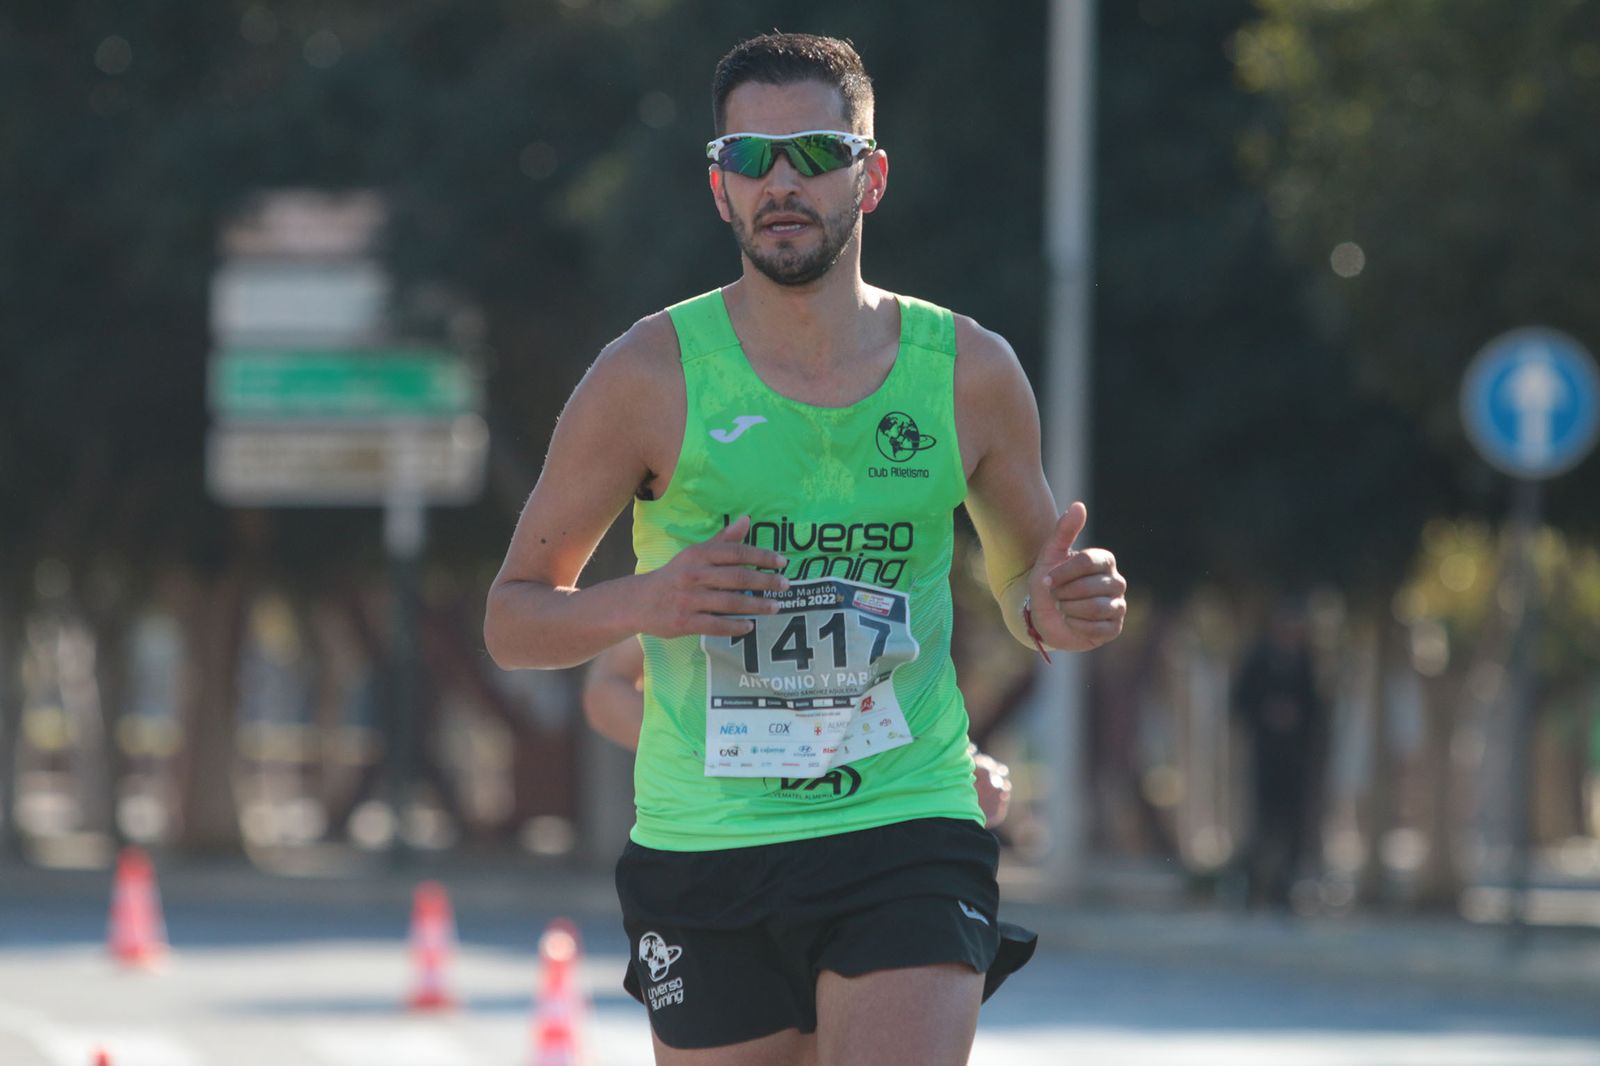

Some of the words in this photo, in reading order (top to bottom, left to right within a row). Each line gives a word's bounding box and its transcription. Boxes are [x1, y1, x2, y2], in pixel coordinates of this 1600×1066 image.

[868, 466, 888, 478] Club
[891, 466, 929, 479] Atletismo
[757, 552, 908, 588] unning
[797, 585, 837, 597] Maratón
[808, 594, 836, 605] 2022
[730, 612, 891, 673] 1417
[738, 674, 815, 691] ANTONIO
[820, 673, 831, 687] Y
[720, 725, 748, 735] NEXA
[769, 722, 790, 734] CDX
